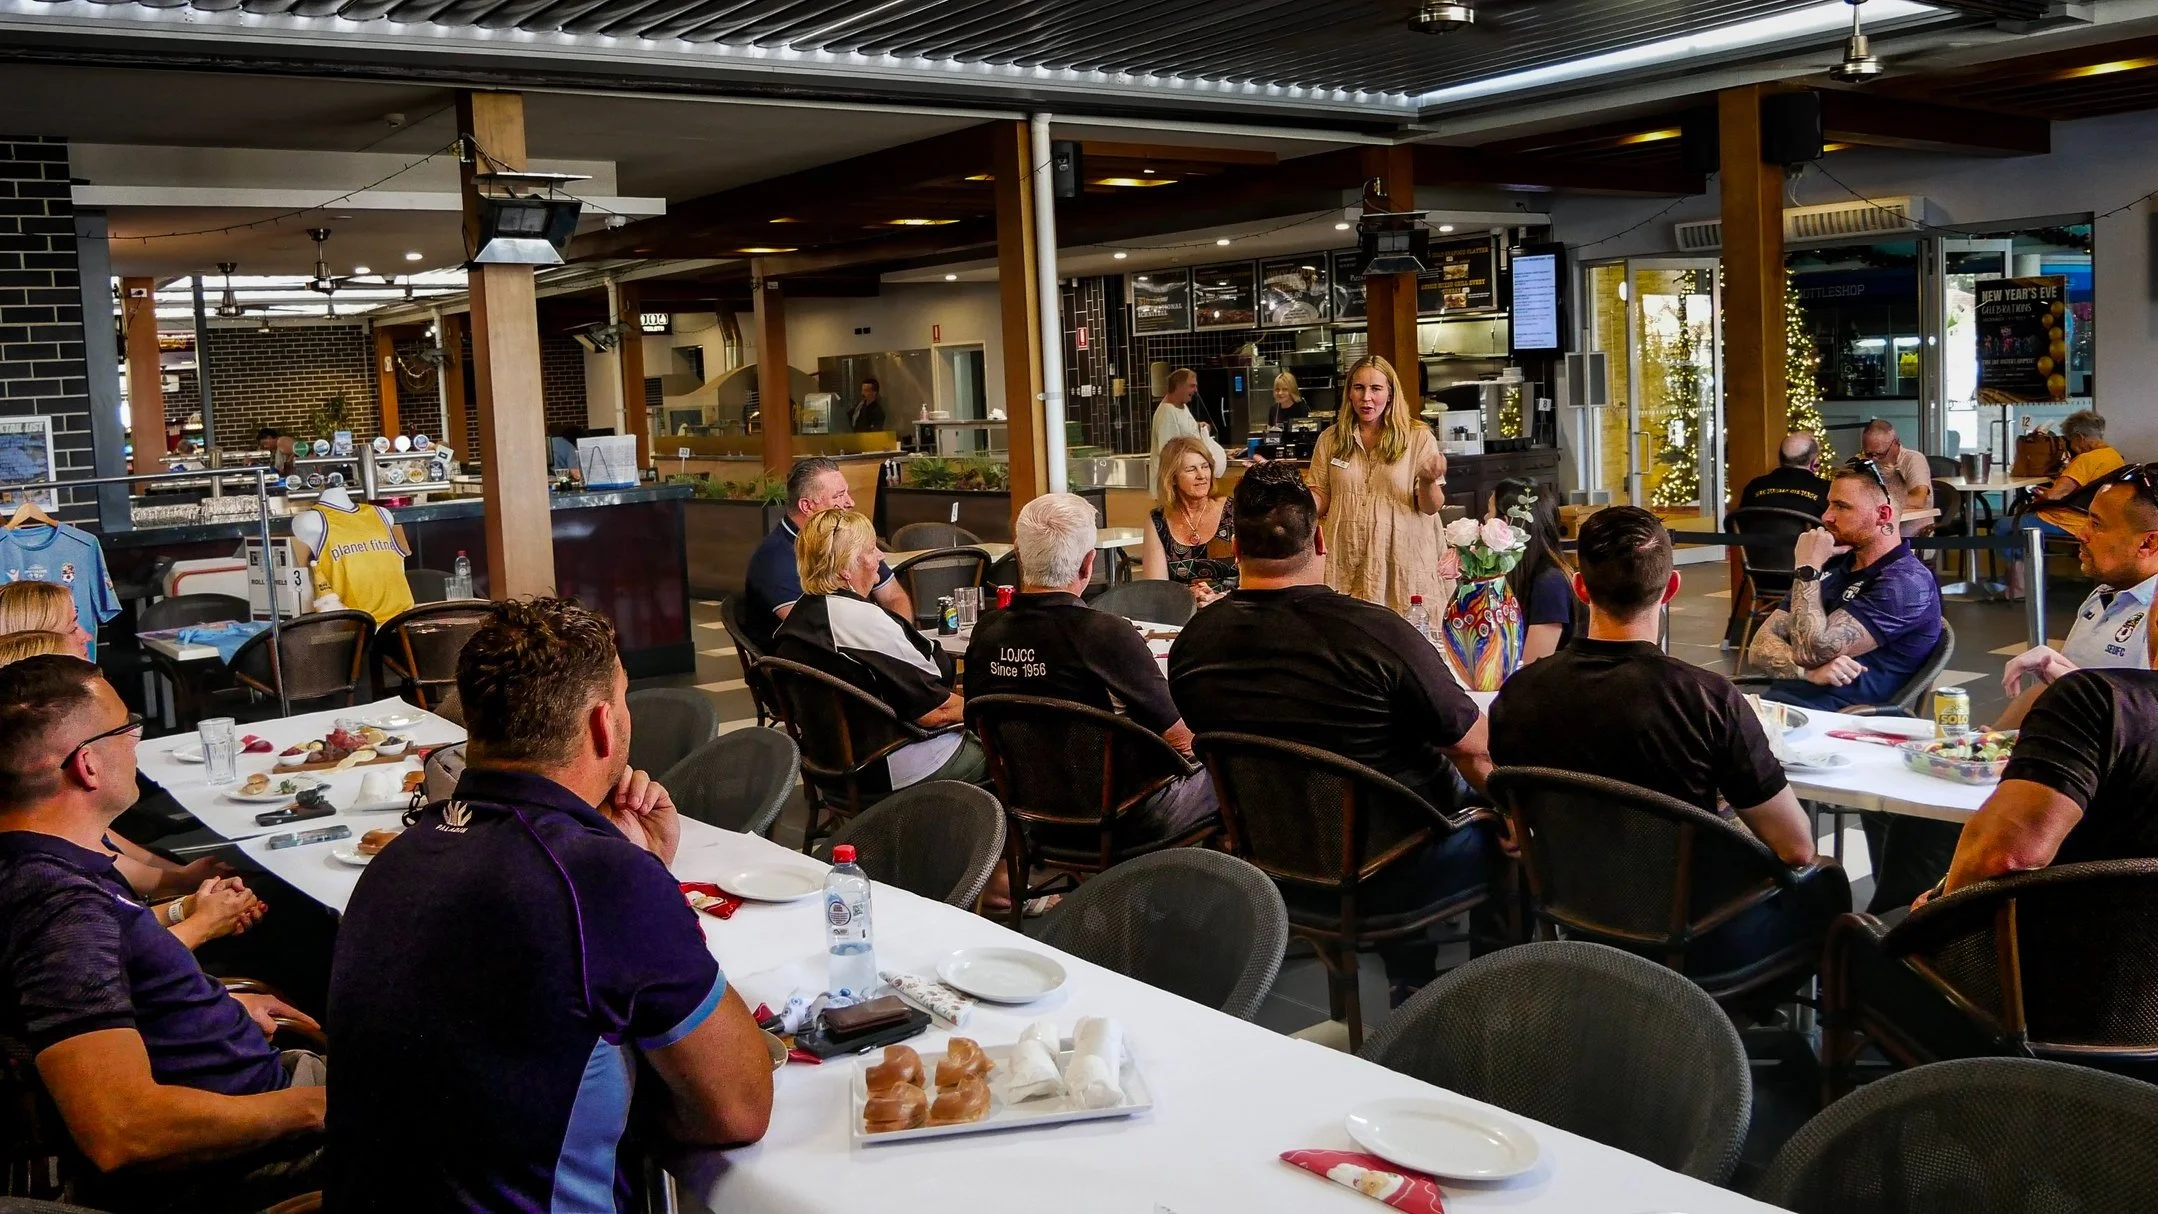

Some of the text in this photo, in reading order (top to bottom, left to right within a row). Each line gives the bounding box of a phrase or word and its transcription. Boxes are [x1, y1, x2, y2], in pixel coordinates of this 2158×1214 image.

[1981, 285, 2057, 302] NEW YEAR'S EVE
[1981, 303, 2032, 315] CELEBRATIONS
[25, 421, 44, 432] LIST
[2022, 416, 2031, 427] 12
[331, 541, 369, 561] planet
[251, 578, 265, 586] ROLL
[293, 569, 302, 586] 3
[1000, 647, 1035, 662] LOJCC
[990, 661, 1046, 678] Since 1956
[1940, 714, 1969, 725] SOLO
